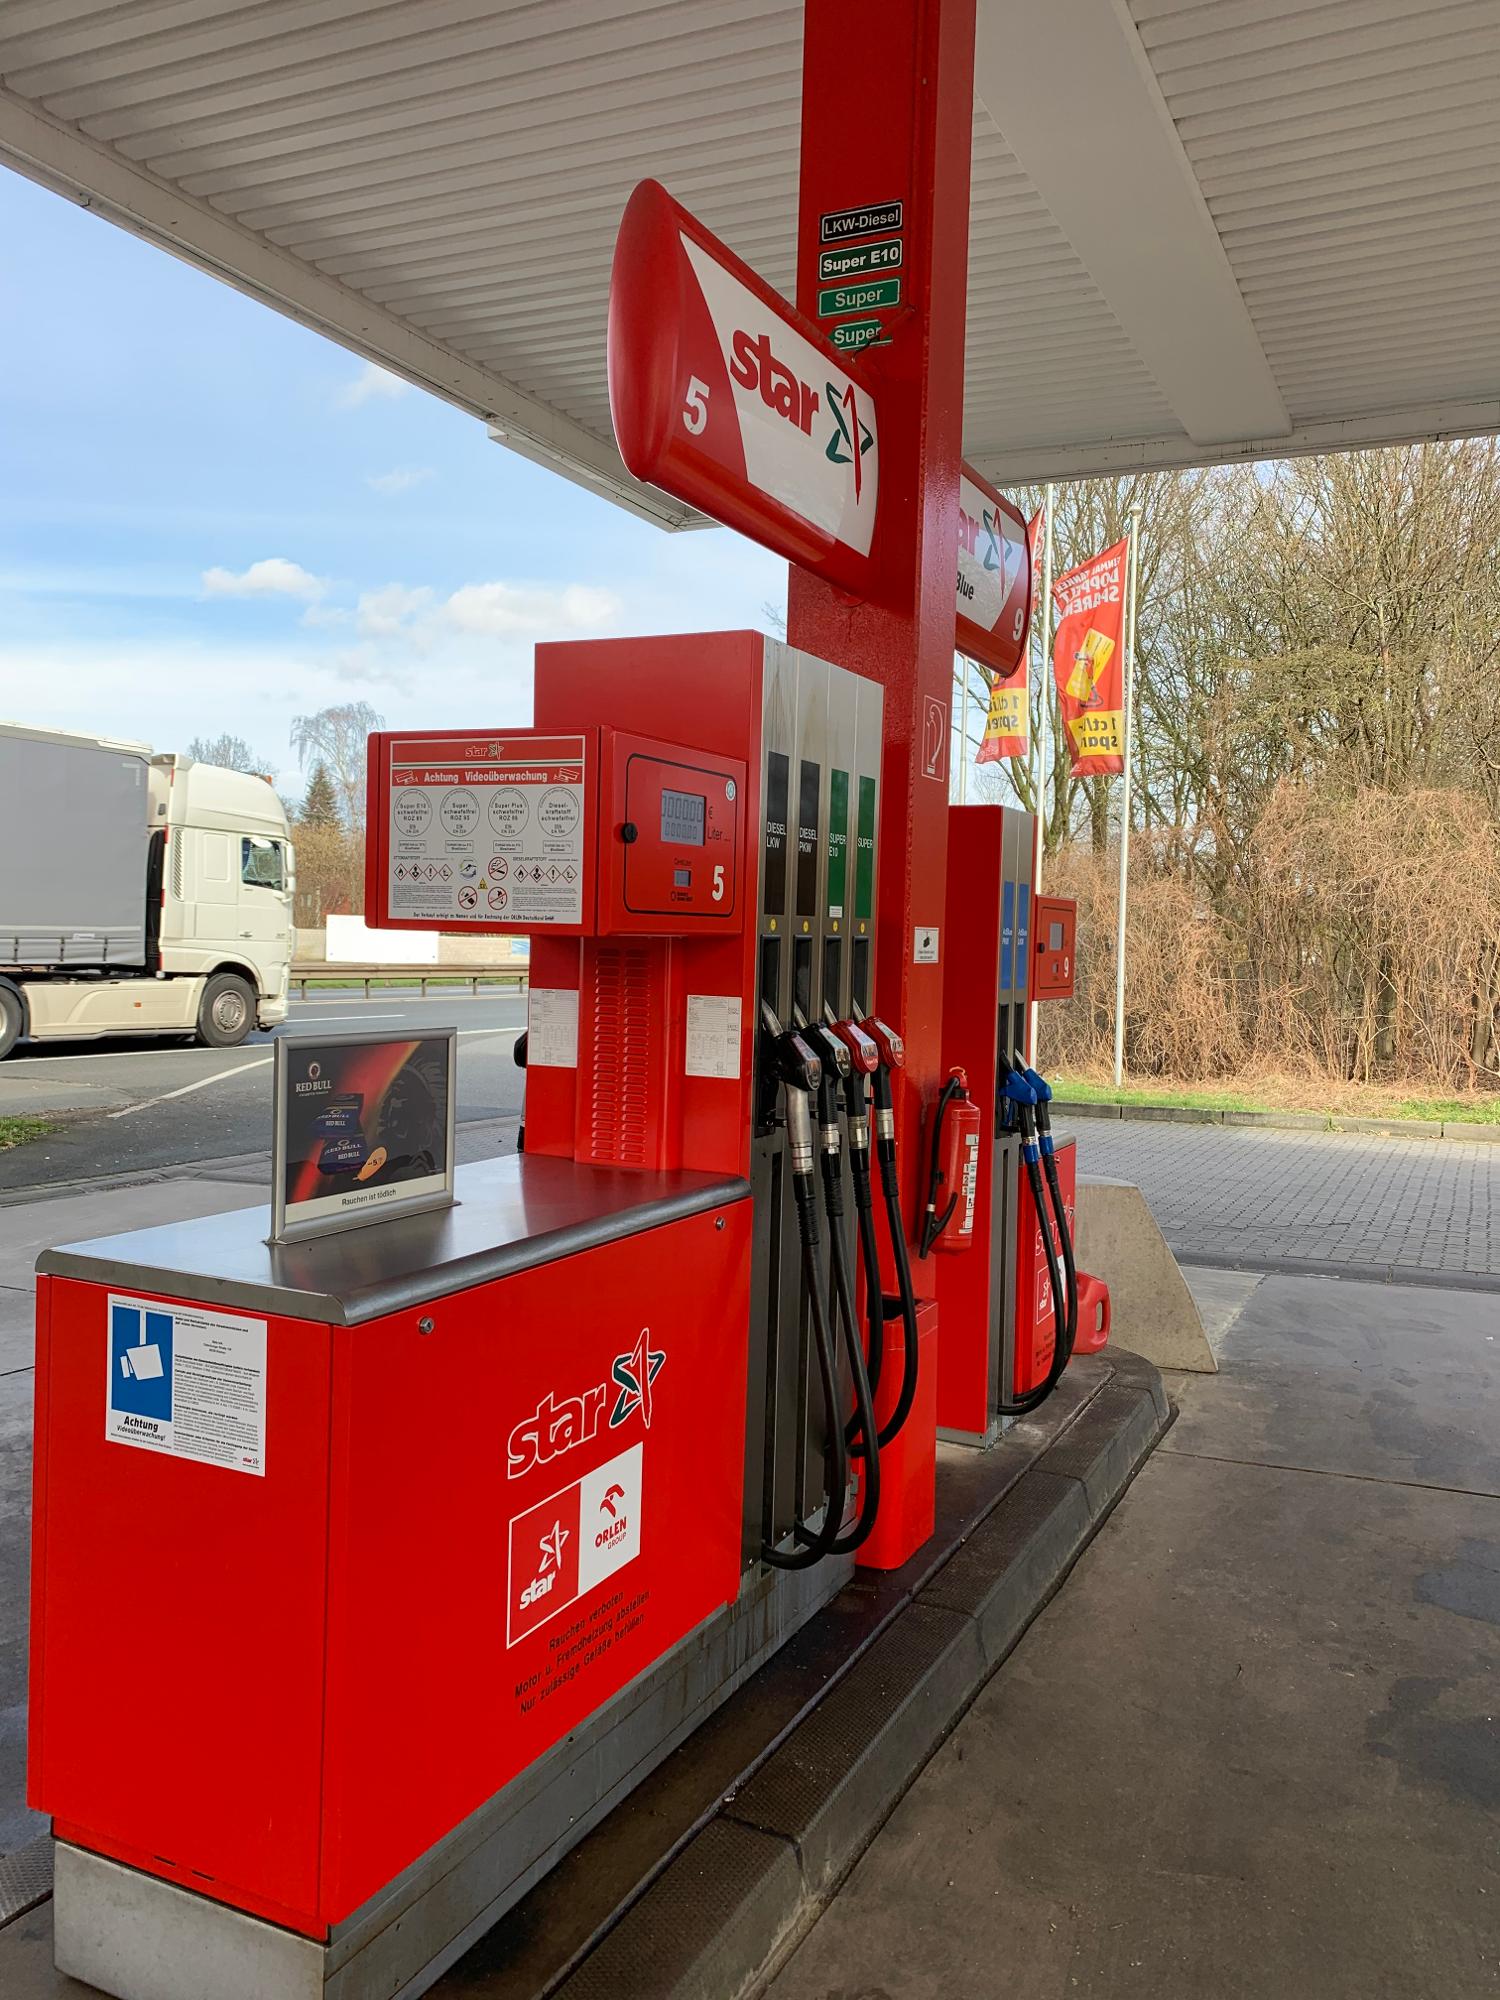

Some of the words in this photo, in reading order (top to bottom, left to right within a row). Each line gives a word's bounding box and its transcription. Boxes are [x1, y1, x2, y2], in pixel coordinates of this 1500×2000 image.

[824, 208, 899, 235] LKW-Diesel
[822, 254, 866, 273] Super
[870, 246, 899, 264] E10
[834, 288, 884, 308] Super
[833, 325, 882, 345] Super
[729, 329, 820, 437] star
[681, 375, 710, 436] 5
[1012, 607, 1025, 642] 9
[423, 772, 460, 784] Achtung
[464, 771, 549, 783] Videoüberwachung
[706, 826, 723, 841] Liter
[767, 821, 787, 835] DIESEL
[799, 827, 818, 841] DIESEL
[766, 835, 781, 849] LKW
[799, 841, 813, 853] PKW
[829, 832, 847, 845] SUPER
[857, 837, 874, 849] SUPER
[828, 845, 839, 857] E10
[711, 865, 725, 901] 5
[1063, 956, 1070, 978] 9
[295, 1081, 312, 1093] RED
[312, 1079, 332, 1091] BULL
[341, 1195, 368, 1207] Rauchen
[368, 1193, 377, 1202] ist
[376, 1188, 397, 1201] tödlich
[116, 1424, 166, 1442] Videoüberwachung!
[123, 1415, 160, 1433] Achtung
[506, 1382, 607, 1480] star
[594, 1515, 628, 1549] ORLEN
[607, 1532, 627, 1551] GROUP
[519, 1570, 557, 1611] star
[548, 1618, 586, 1652] Rauchen
[588, 1590, 624, 1622] verboten
[514, 1671, 542, 1699] Motor
[556, 1617, 613, 1668] Fremdheizung
[615, 1590, 650, 1623] abstellen
[520, 1696, 537, 1714] Nur
[540, 1662, 580, 1700] zulässige
[583, 1637, 612, 1666] Gefäße
[614, 1614, 645, 1641] befüllen
